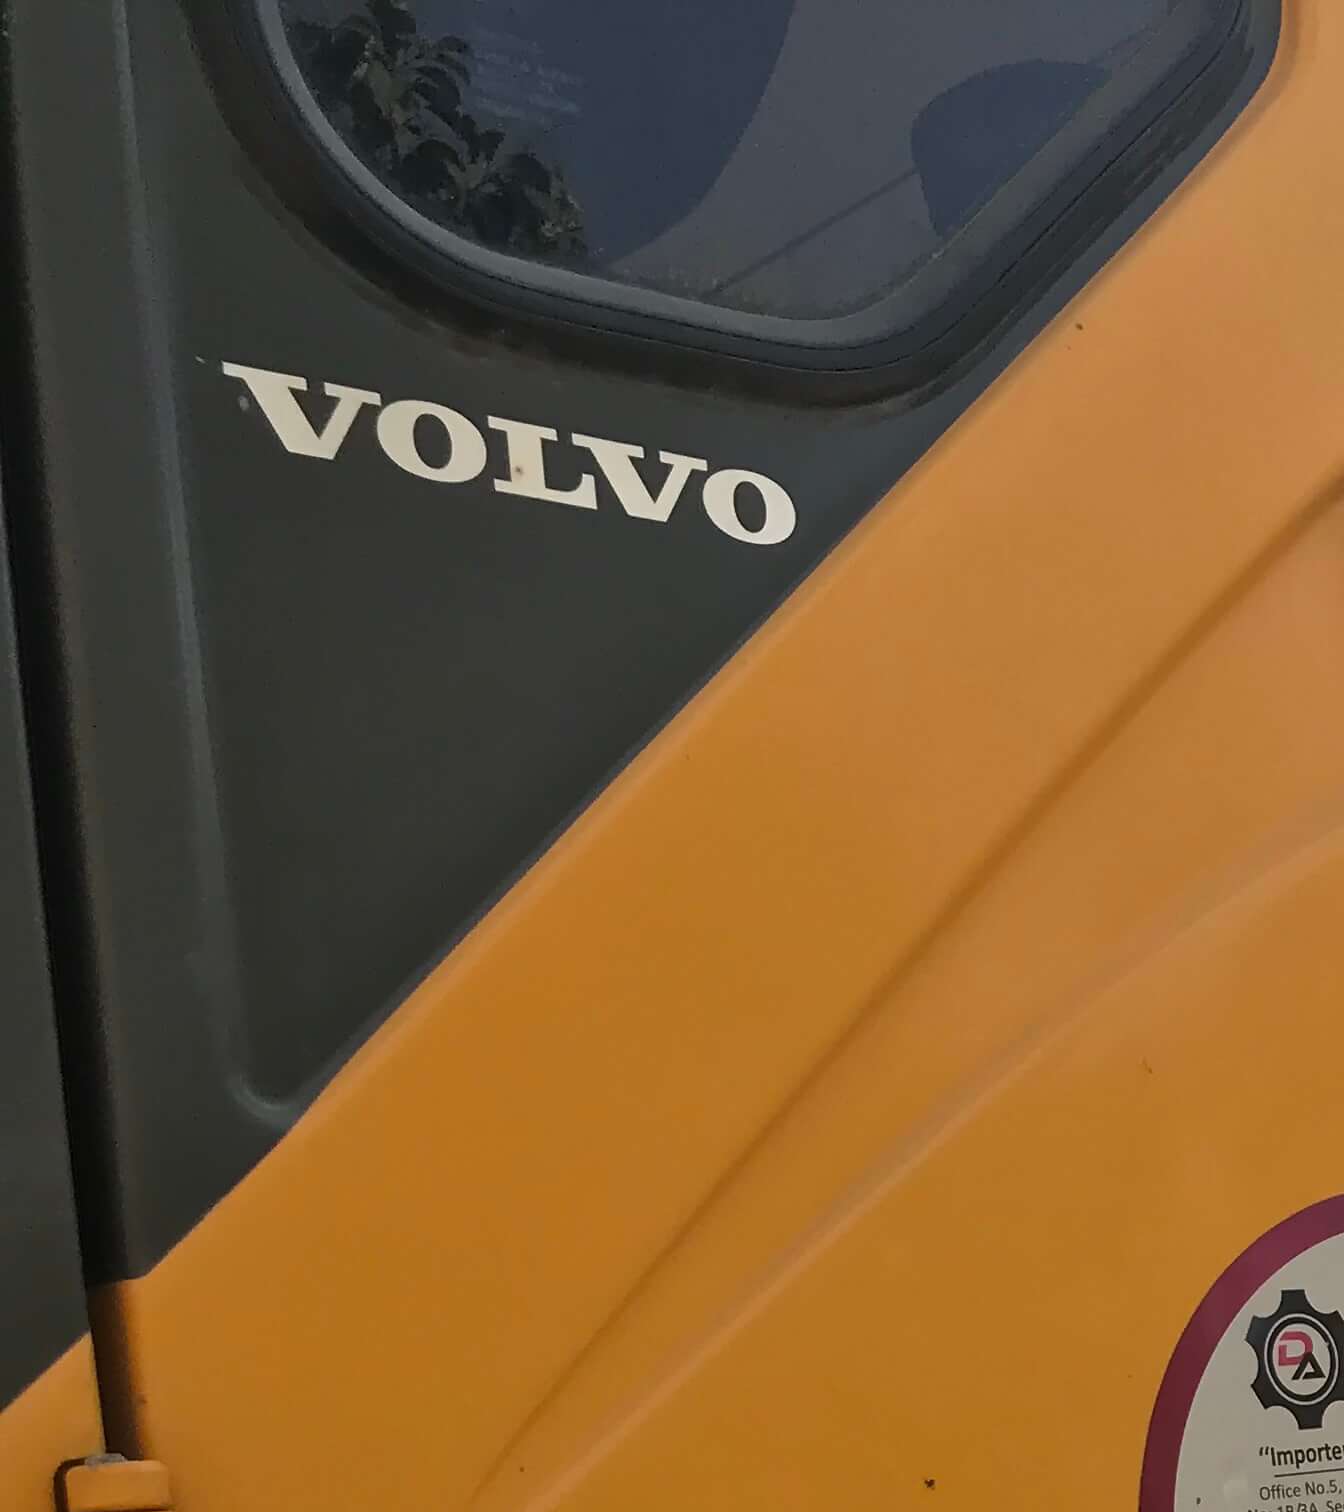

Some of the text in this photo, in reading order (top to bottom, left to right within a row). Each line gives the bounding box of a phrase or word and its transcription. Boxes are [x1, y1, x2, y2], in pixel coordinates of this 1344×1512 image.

[221, 360, 797, 546] VOLVO
[1259, 1484, 1301, 1501] Office
[1305, 1479, 1342, 1496] No.5,
